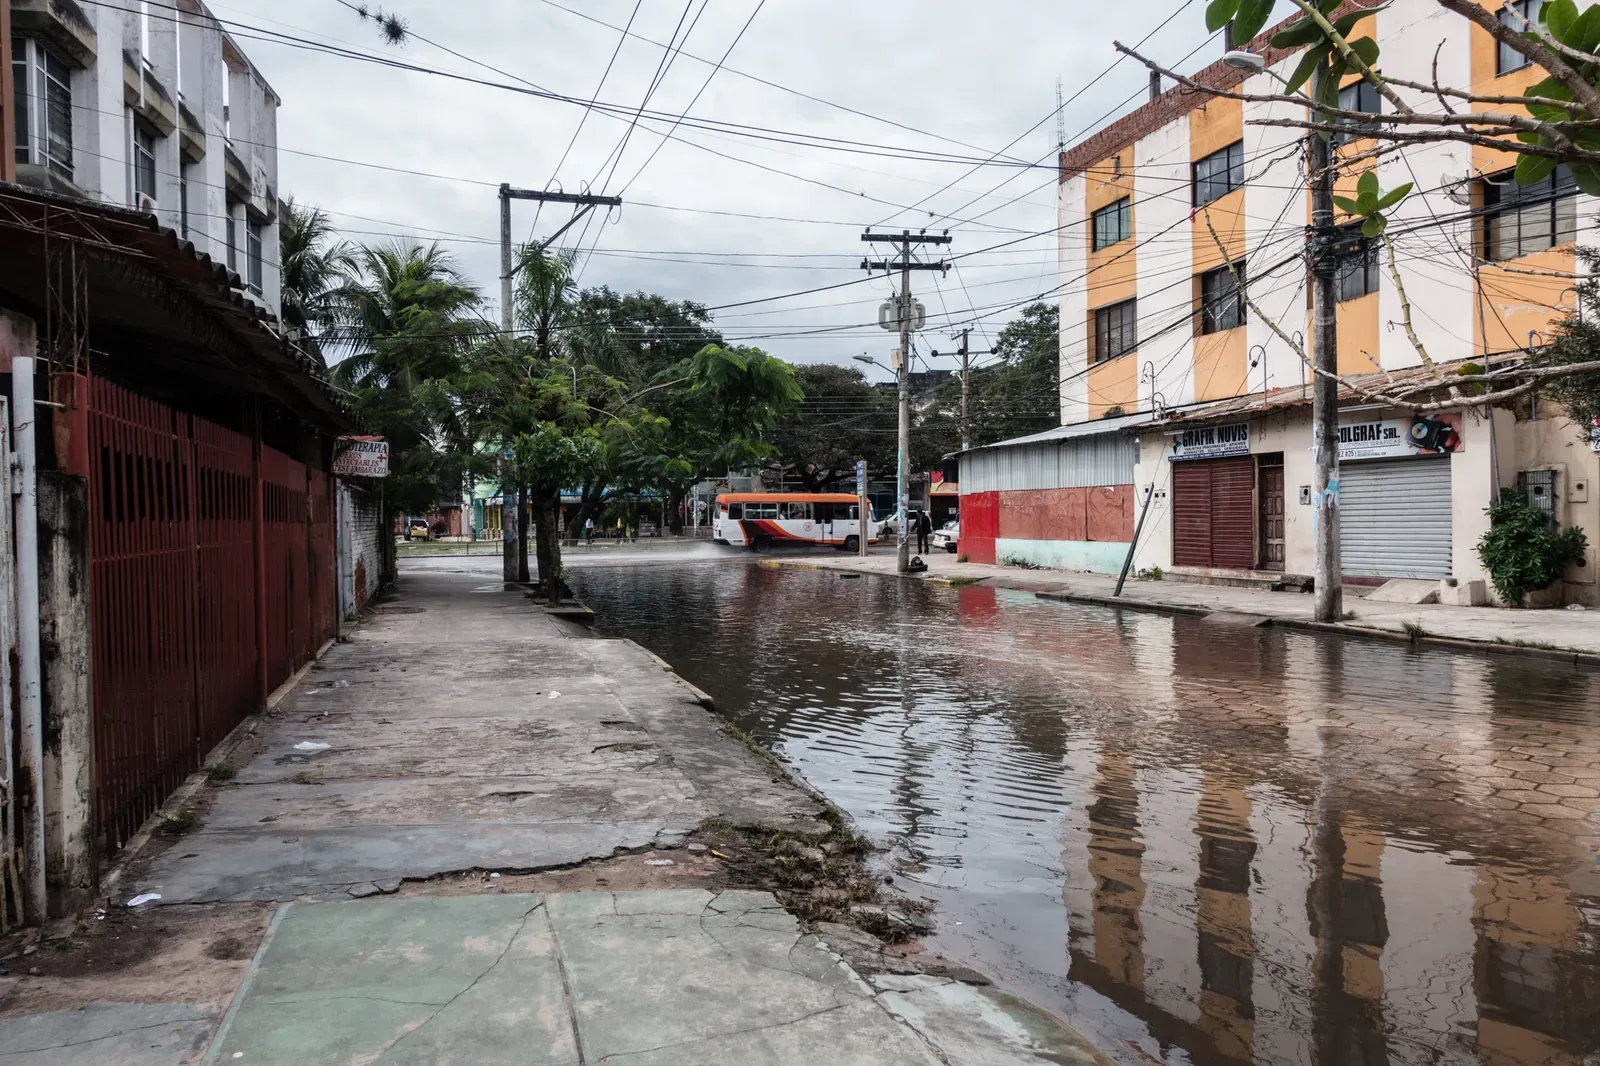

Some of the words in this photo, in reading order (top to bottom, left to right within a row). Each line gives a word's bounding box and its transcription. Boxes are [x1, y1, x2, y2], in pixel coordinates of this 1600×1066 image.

[1182, 428, 1215, 447] GRAFIK
[1217, 424, 1248, 444] NUVIS
[1384, 427, 1401, 439] SRL.
[1338, 441, 1369, 449] OLUCIONES
[336, 451, 362, 459] UEROS
[351, 465, 387, 474] EMBARAZO
